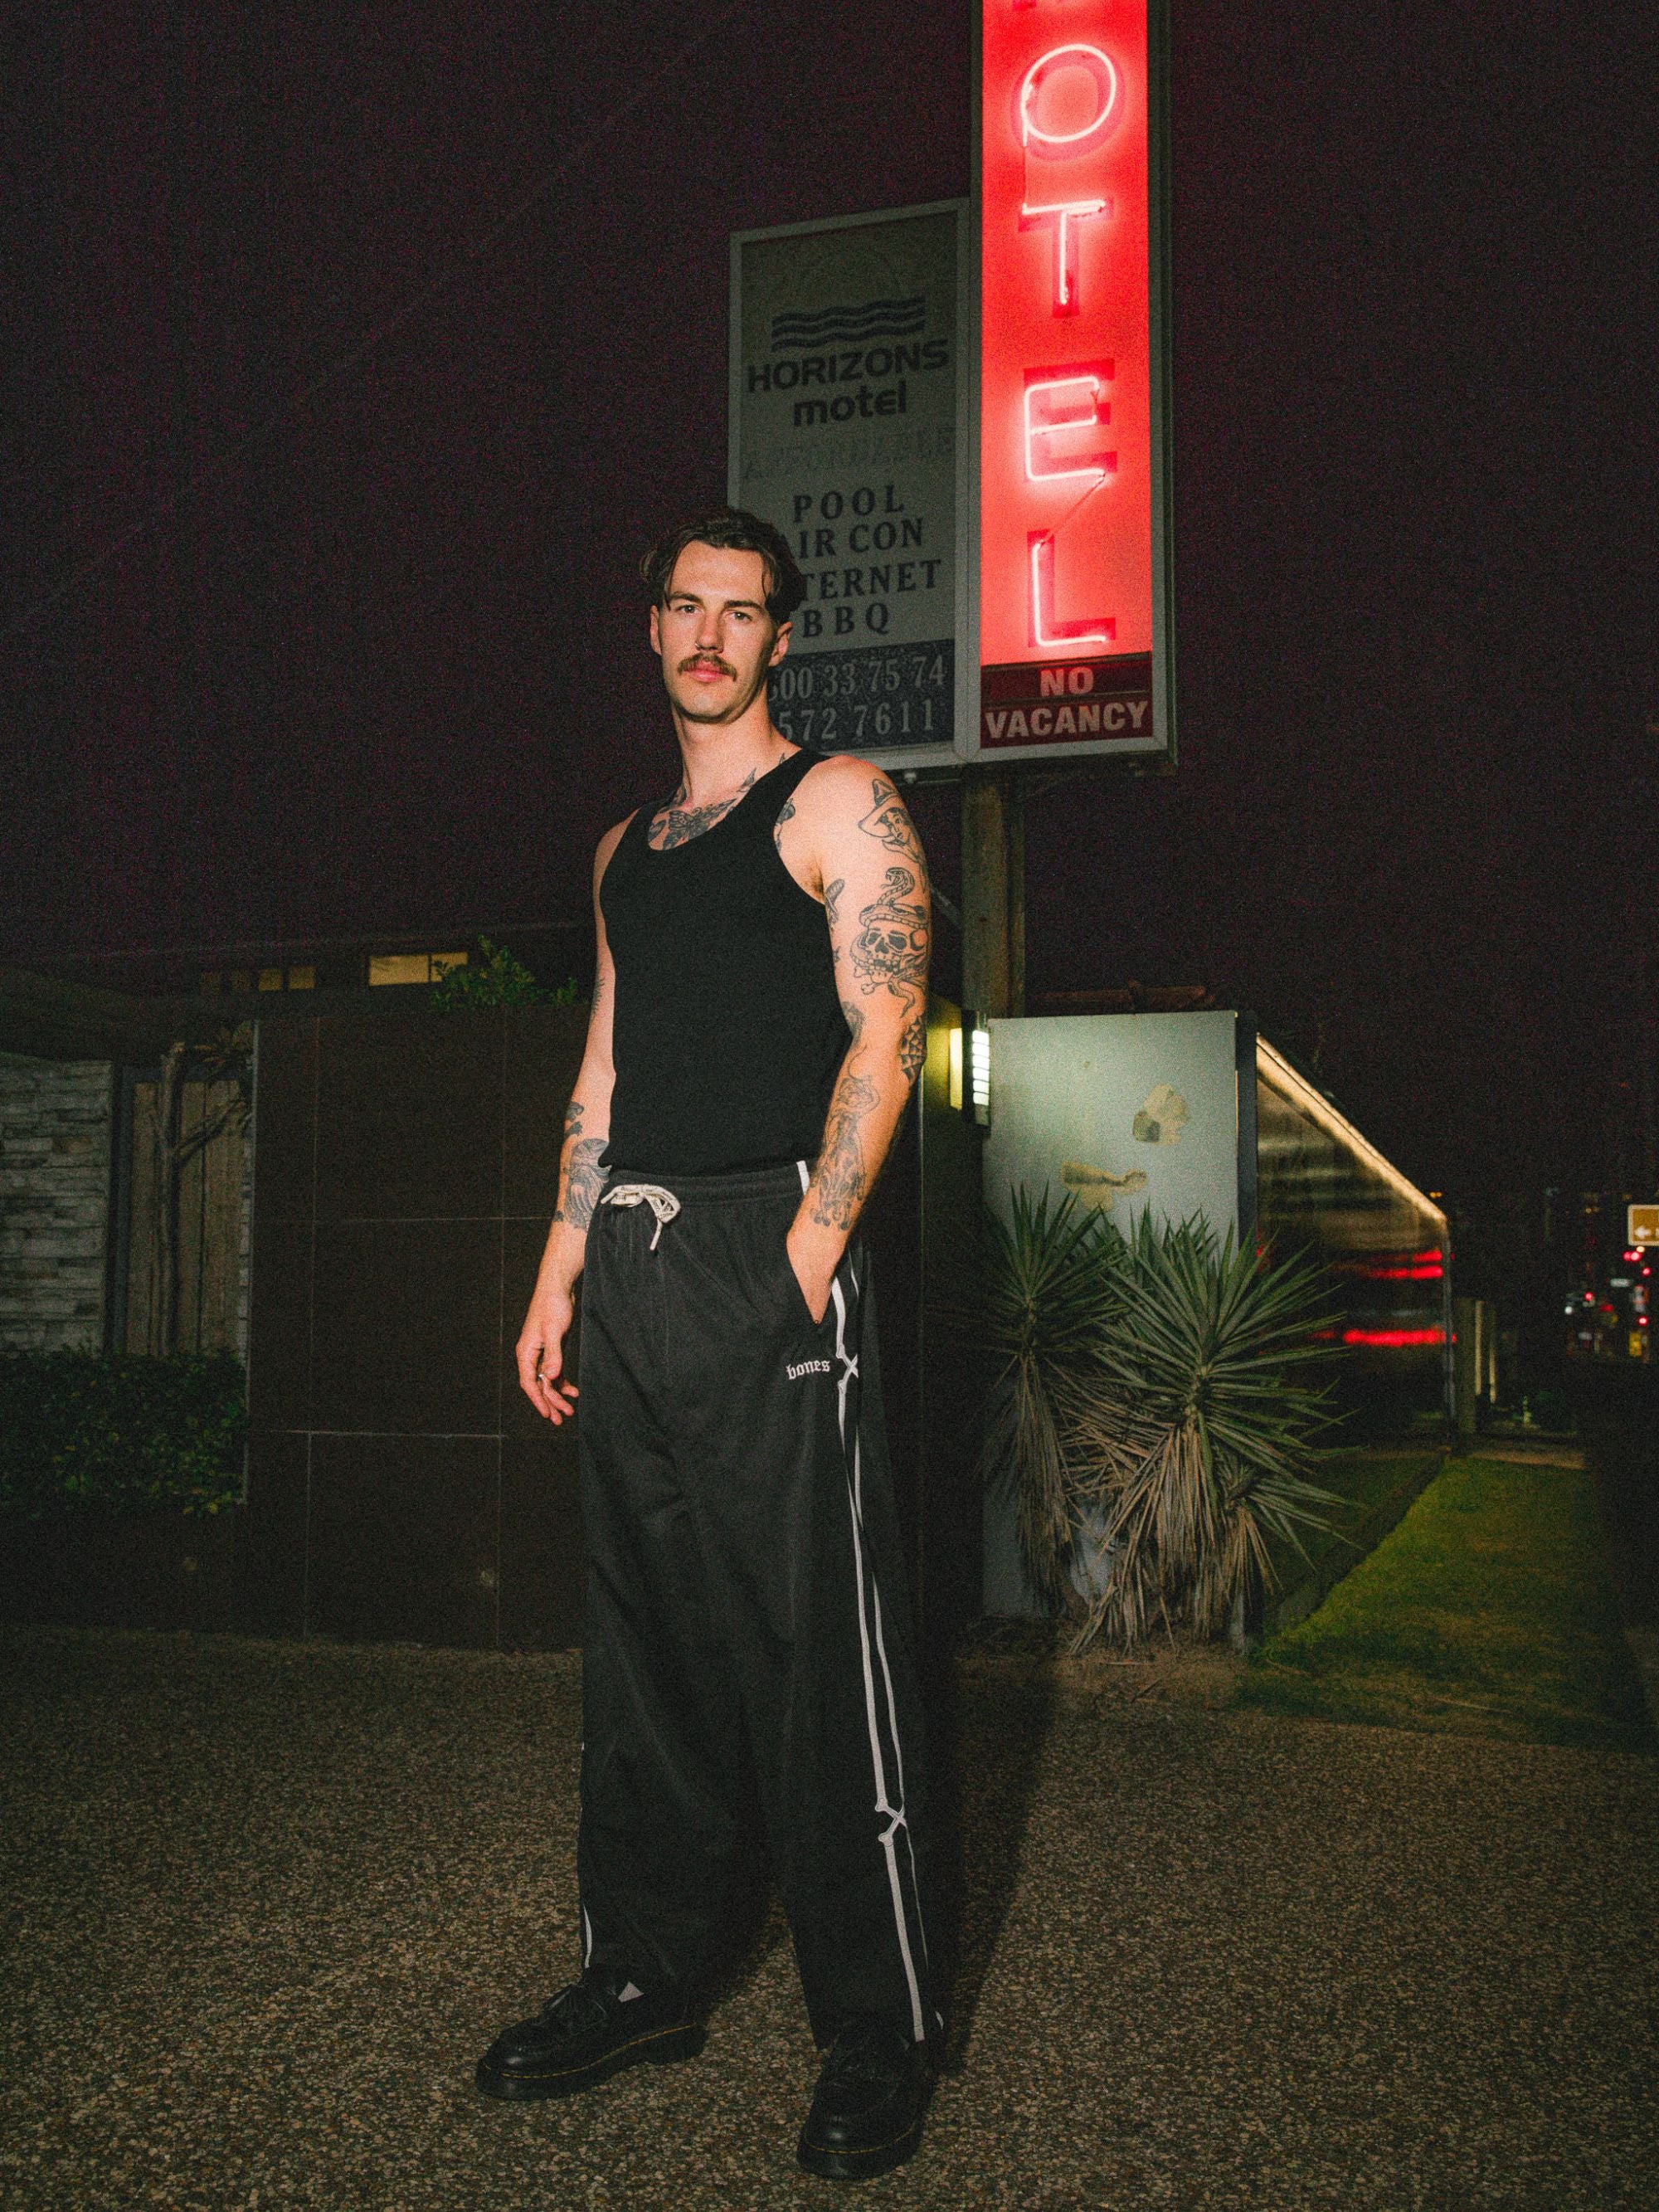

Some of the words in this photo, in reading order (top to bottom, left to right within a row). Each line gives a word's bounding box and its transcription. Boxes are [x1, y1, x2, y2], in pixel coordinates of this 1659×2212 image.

[1010, 0, 1117, 648] OTEL
[747, 339, 949, 392] HORIZONS
[793, 382, 907, 427] motel
[792, 485, 904, 523] POOL
[849, 518, 923, 553] CON
[801, 559, 942, 603] TERNET
[801, 602, 890, 639] BBQ
[824, 664, 857, 698] 33
[868, 658, 902, 693] 75
[912, 655, 946, 689] 74
[1039, 666, 1094, 698] NO
[853, 699, 935, 738] 7611
[985, 702, 1148, 738] VACANCY
[786, 1359, 830, 1380] bones
